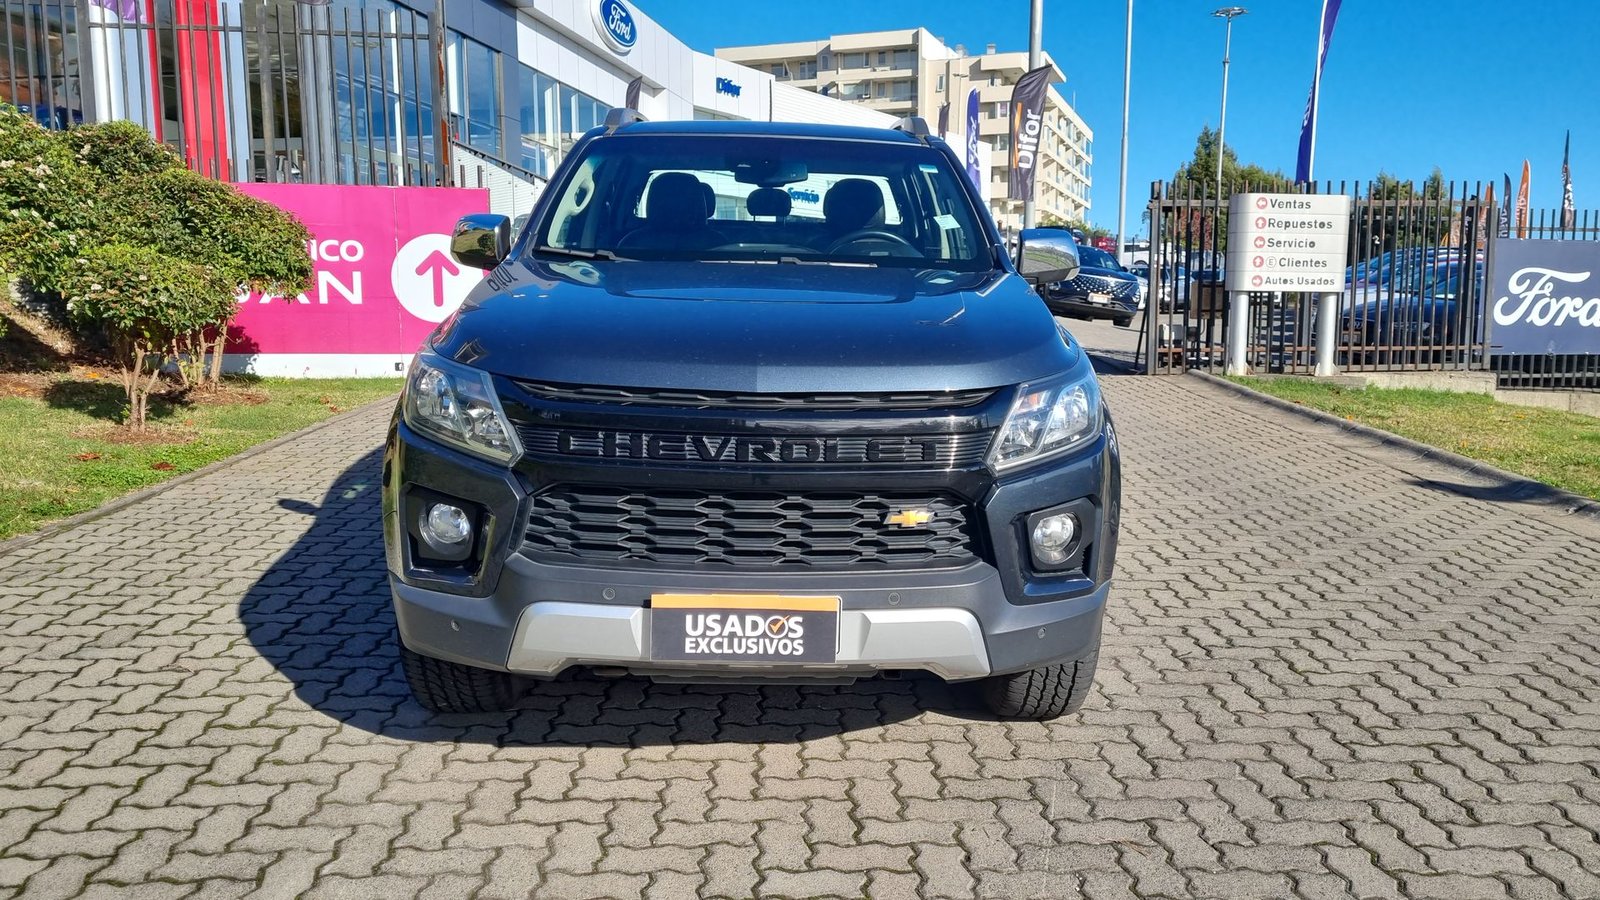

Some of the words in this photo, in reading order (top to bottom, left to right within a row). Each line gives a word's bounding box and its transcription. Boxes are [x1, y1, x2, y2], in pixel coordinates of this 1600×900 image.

[608, 3, 632, 41] Ford
[1018, 109, 1041, 169] Difor
[1269, 198, 1312, 210] Ventas
[1267, 217, 1333, 231] Repuestos
[1267, 237, 1316, 249] Servicio
[1278, 257, 1328, 268] Clientes
[1264, 276, 1294, 286] Autos
[1297, 277, 1335, 286] Usados
[558, 430, 946, 463] CHEVROLET
[685, 614, 804, 638] USADOS
[684, 637, 804, 656] EXCLUSIVOS
